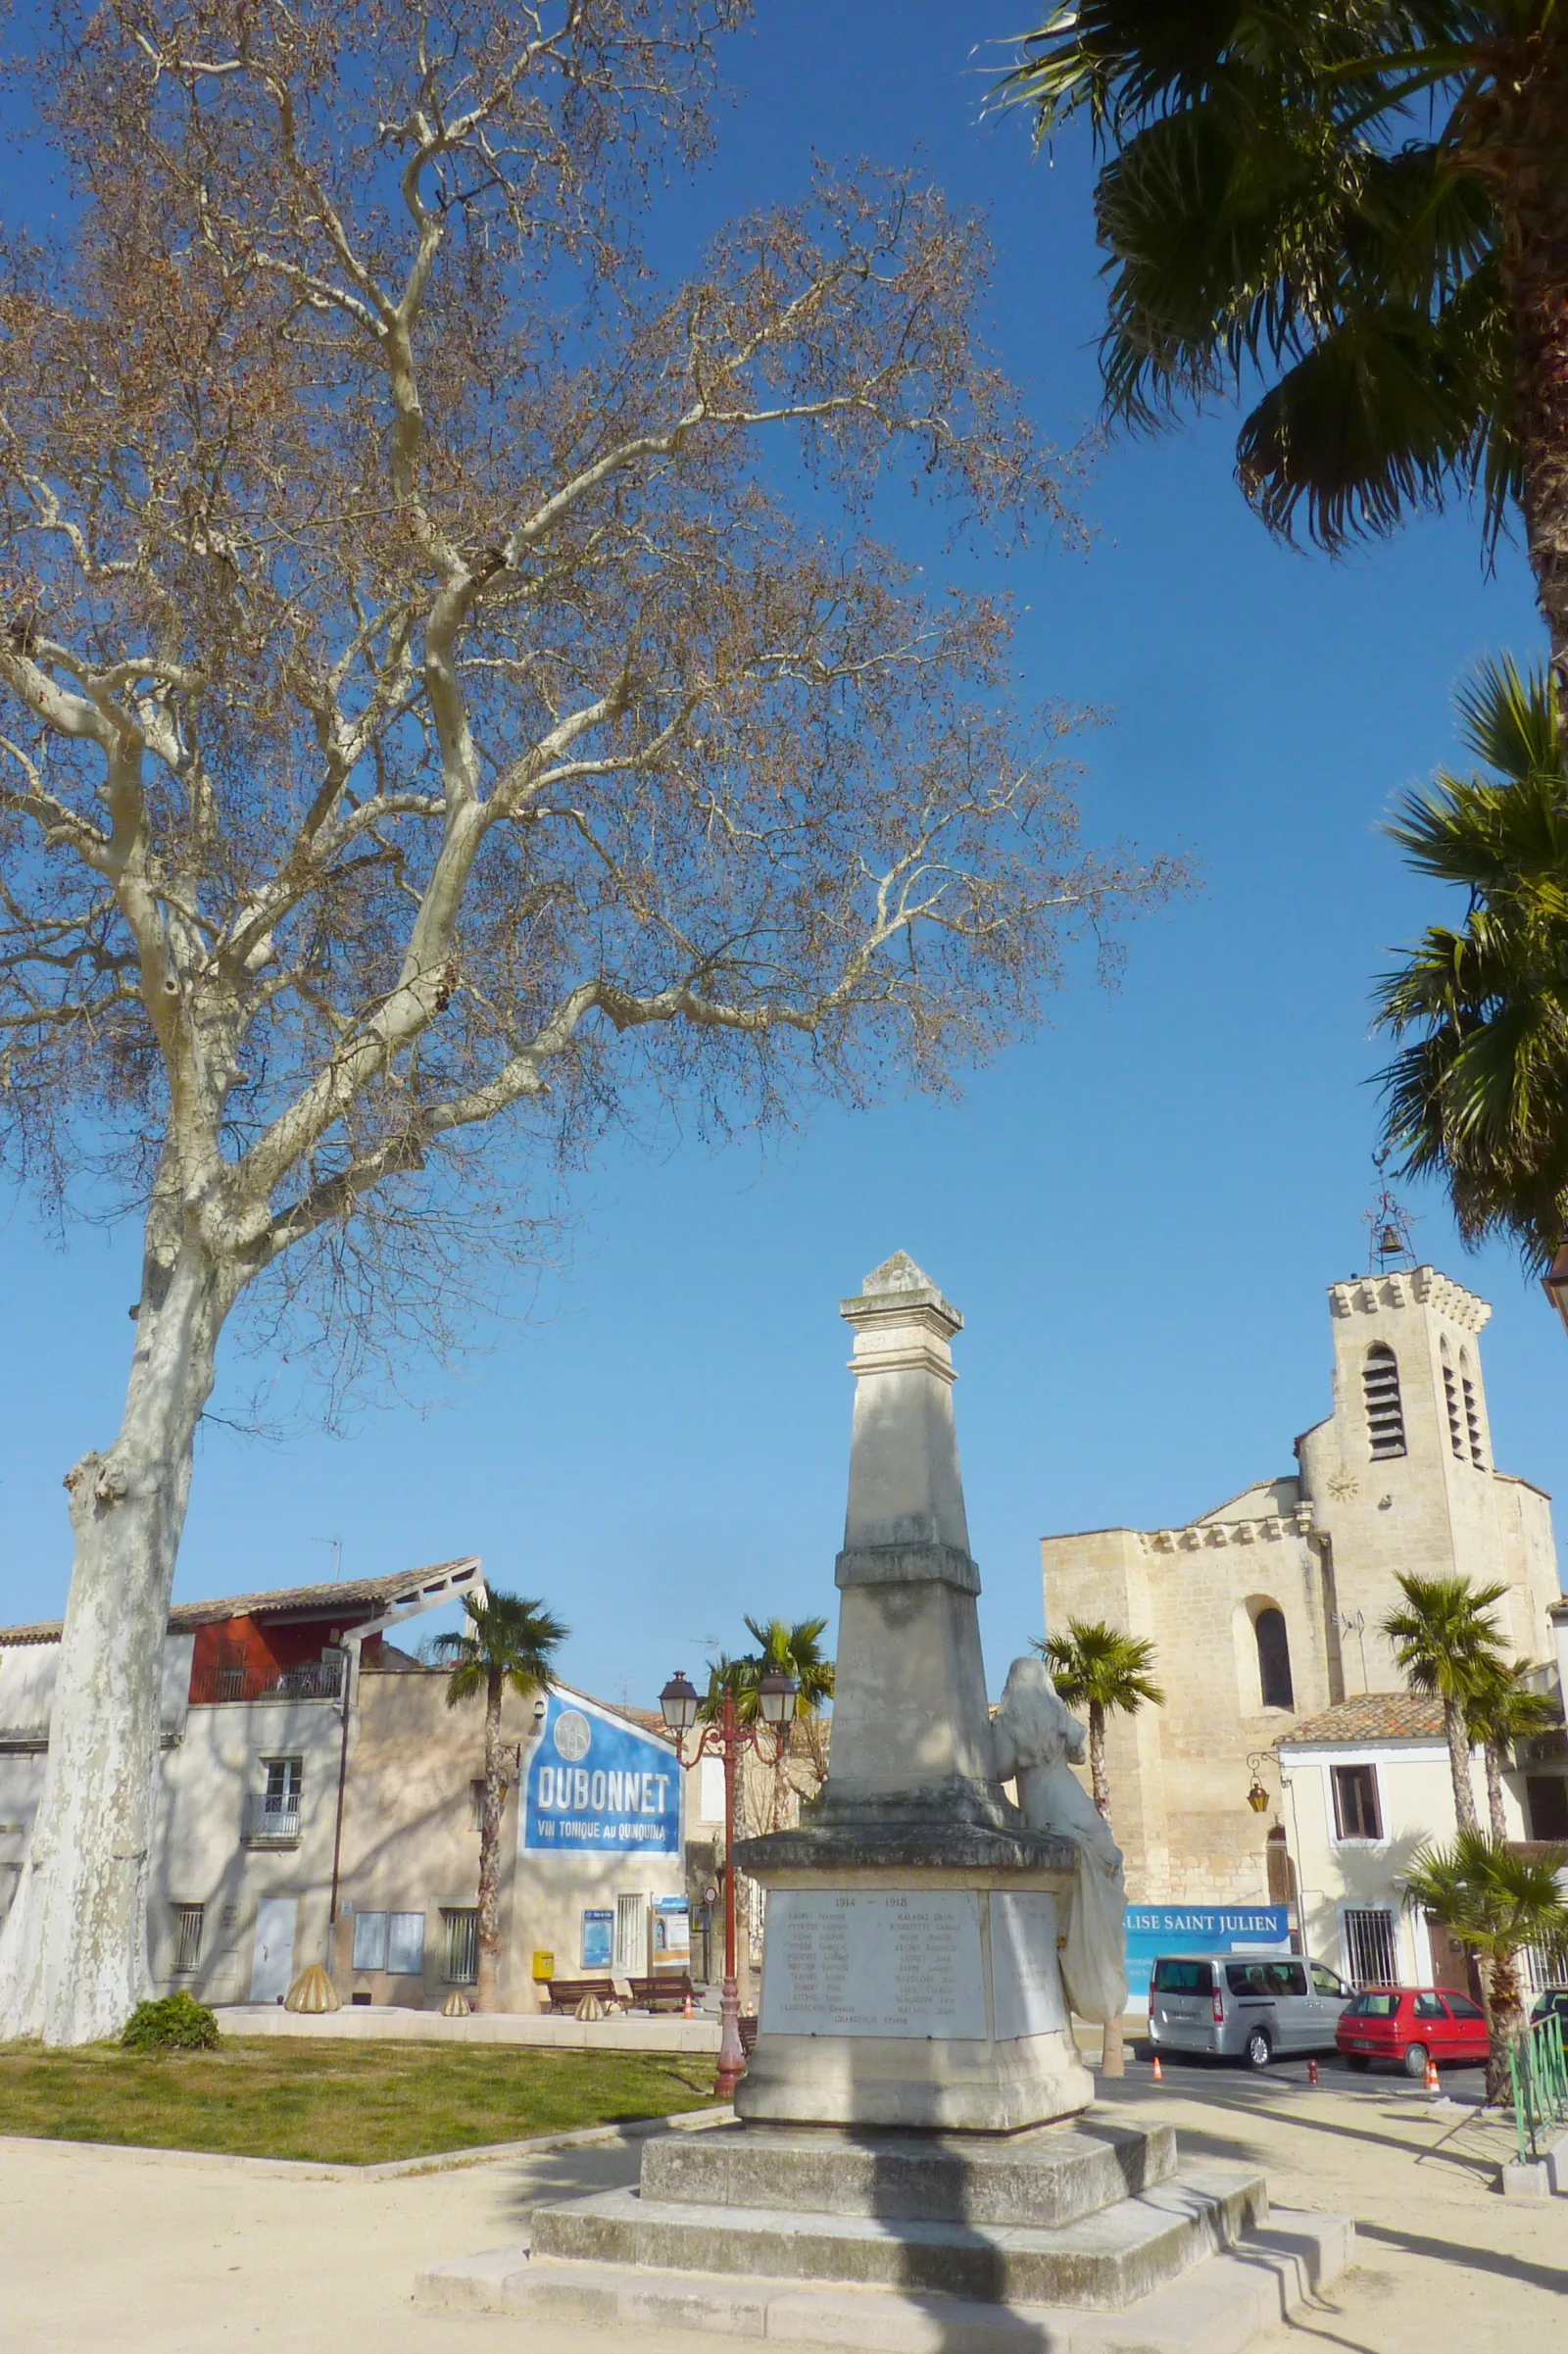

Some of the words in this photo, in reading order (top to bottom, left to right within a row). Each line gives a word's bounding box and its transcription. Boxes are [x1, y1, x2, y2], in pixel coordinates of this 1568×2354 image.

[538, 1766, 669, 1814] DUBONNET
[538, 1820, 555, 1838] VIN
[560, 1821, 600, 1840] TONIQUE
[603, 1825, 615, 1839] AU
[618, 1823, 665, 1841] QUINQUINA
[836, 1898, 856, 1907] 1914
[886, 1898, 907, 1907] 1918
[1123, 1915, 1160, 1930] LISE
[1164, 1915, 1215, 1931] SAINT
[1219, 1916, 1278, 1934] JULIEN
